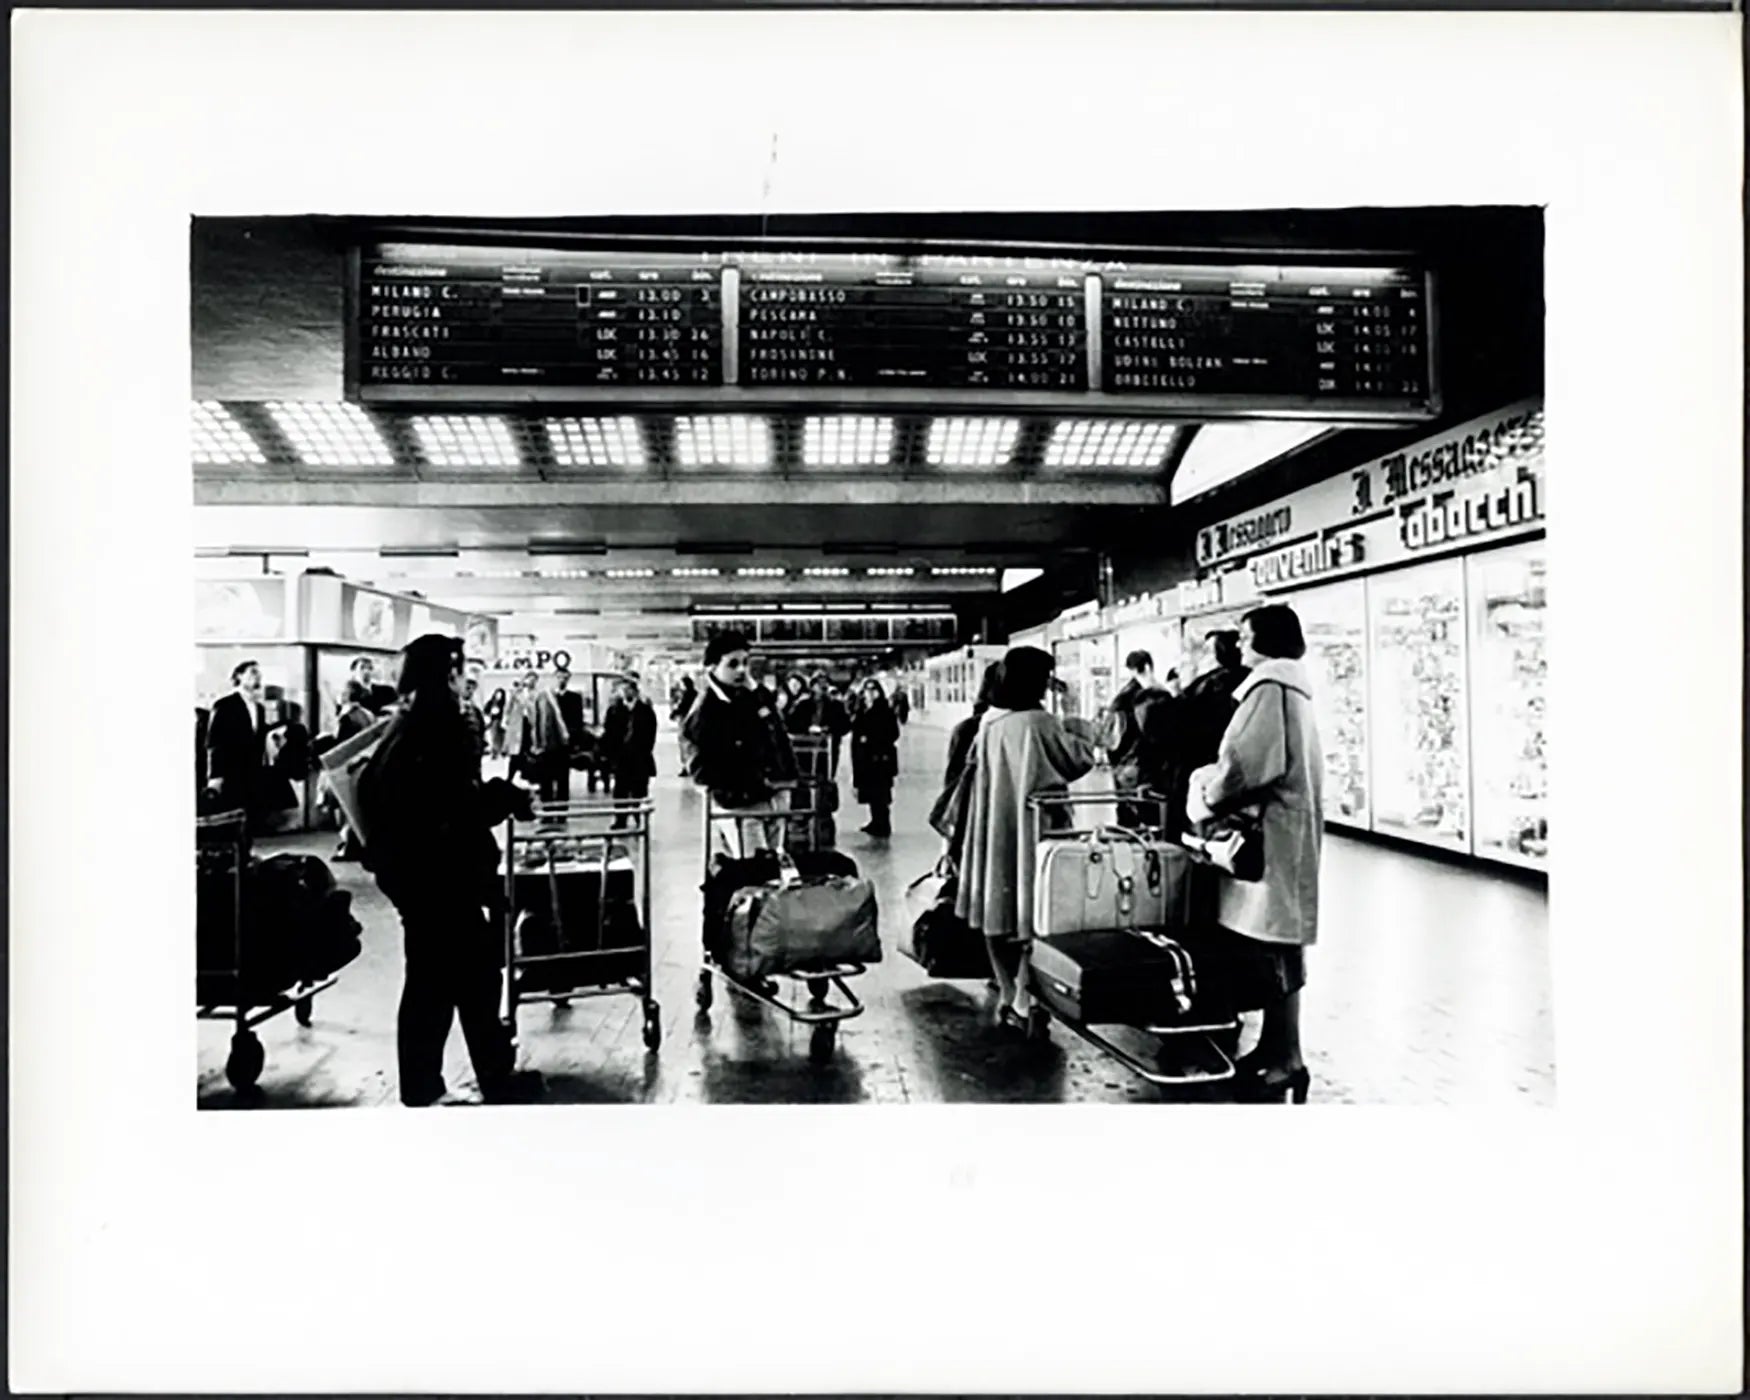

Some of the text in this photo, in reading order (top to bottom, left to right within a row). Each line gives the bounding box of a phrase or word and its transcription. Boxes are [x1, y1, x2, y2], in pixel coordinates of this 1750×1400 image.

[371, 285, 431, 299] MILANO
[750, 289, 846, 302] CAMPOBASSO
[371, 304, 442, 318] PERUGIA
[1113, 298, 1168, 310] MILANO
[749, 308, 817, 321] PESCARA
[371, 324, 450, 339] FRASCATI
[749, 329, 806, 342] NAPOLI
[371, 345, 432, 359] ALBANO
[371, 365, 432, 379] REGGIO
[751, 367, 808, 381] TORINO
